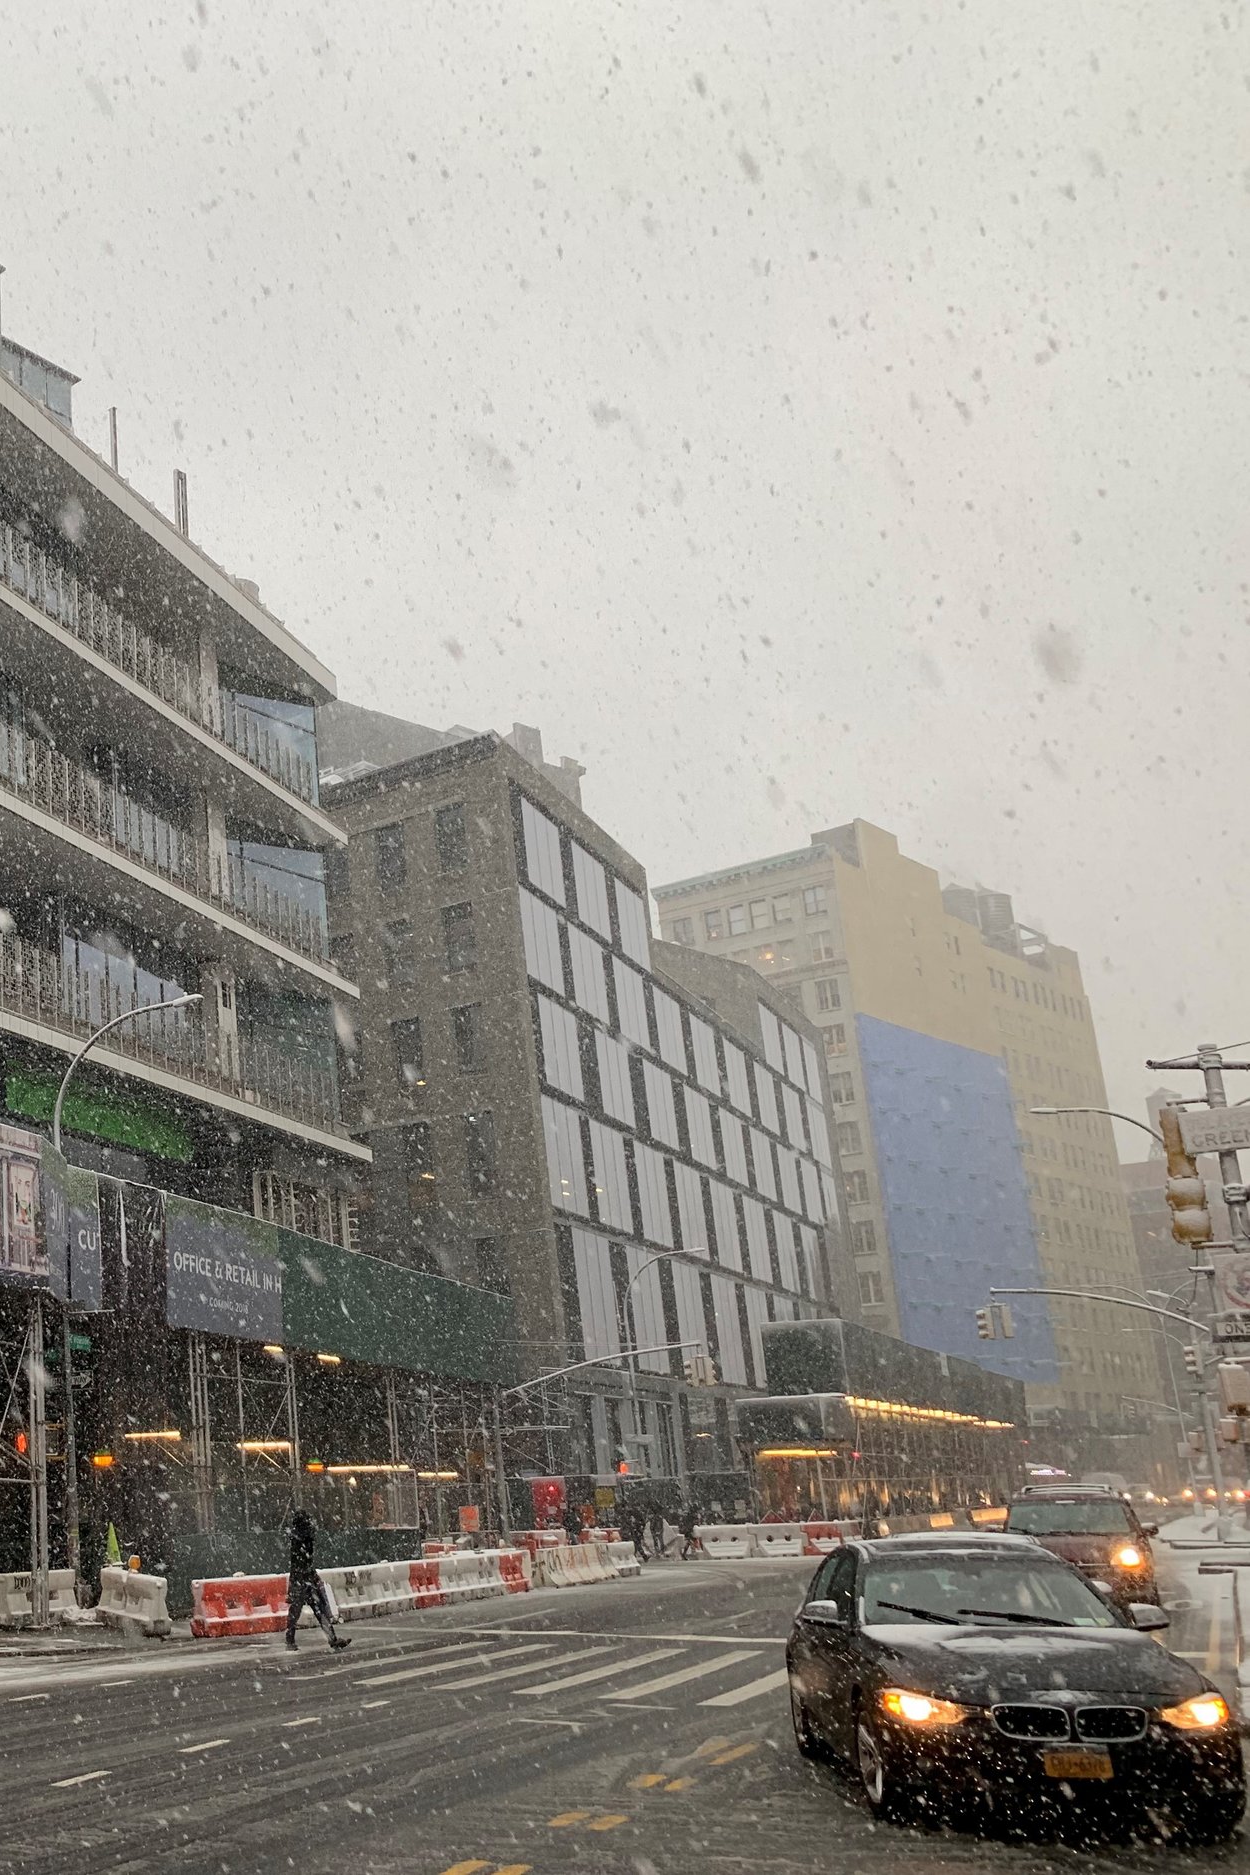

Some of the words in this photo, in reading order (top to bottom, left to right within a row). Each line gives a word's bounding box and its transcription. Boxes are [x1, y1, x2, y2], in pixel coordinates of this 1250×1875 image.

[174, 1251, 212, 1277] OFFICE
[214, 1261, 223, 1279] &
[225, 1264, 261, 1288] RETAIL
[263, 1272, 273, 1291] IN
[275, 1275, 282, 1294] H
[209, 1297, 234, 1311] COMING
